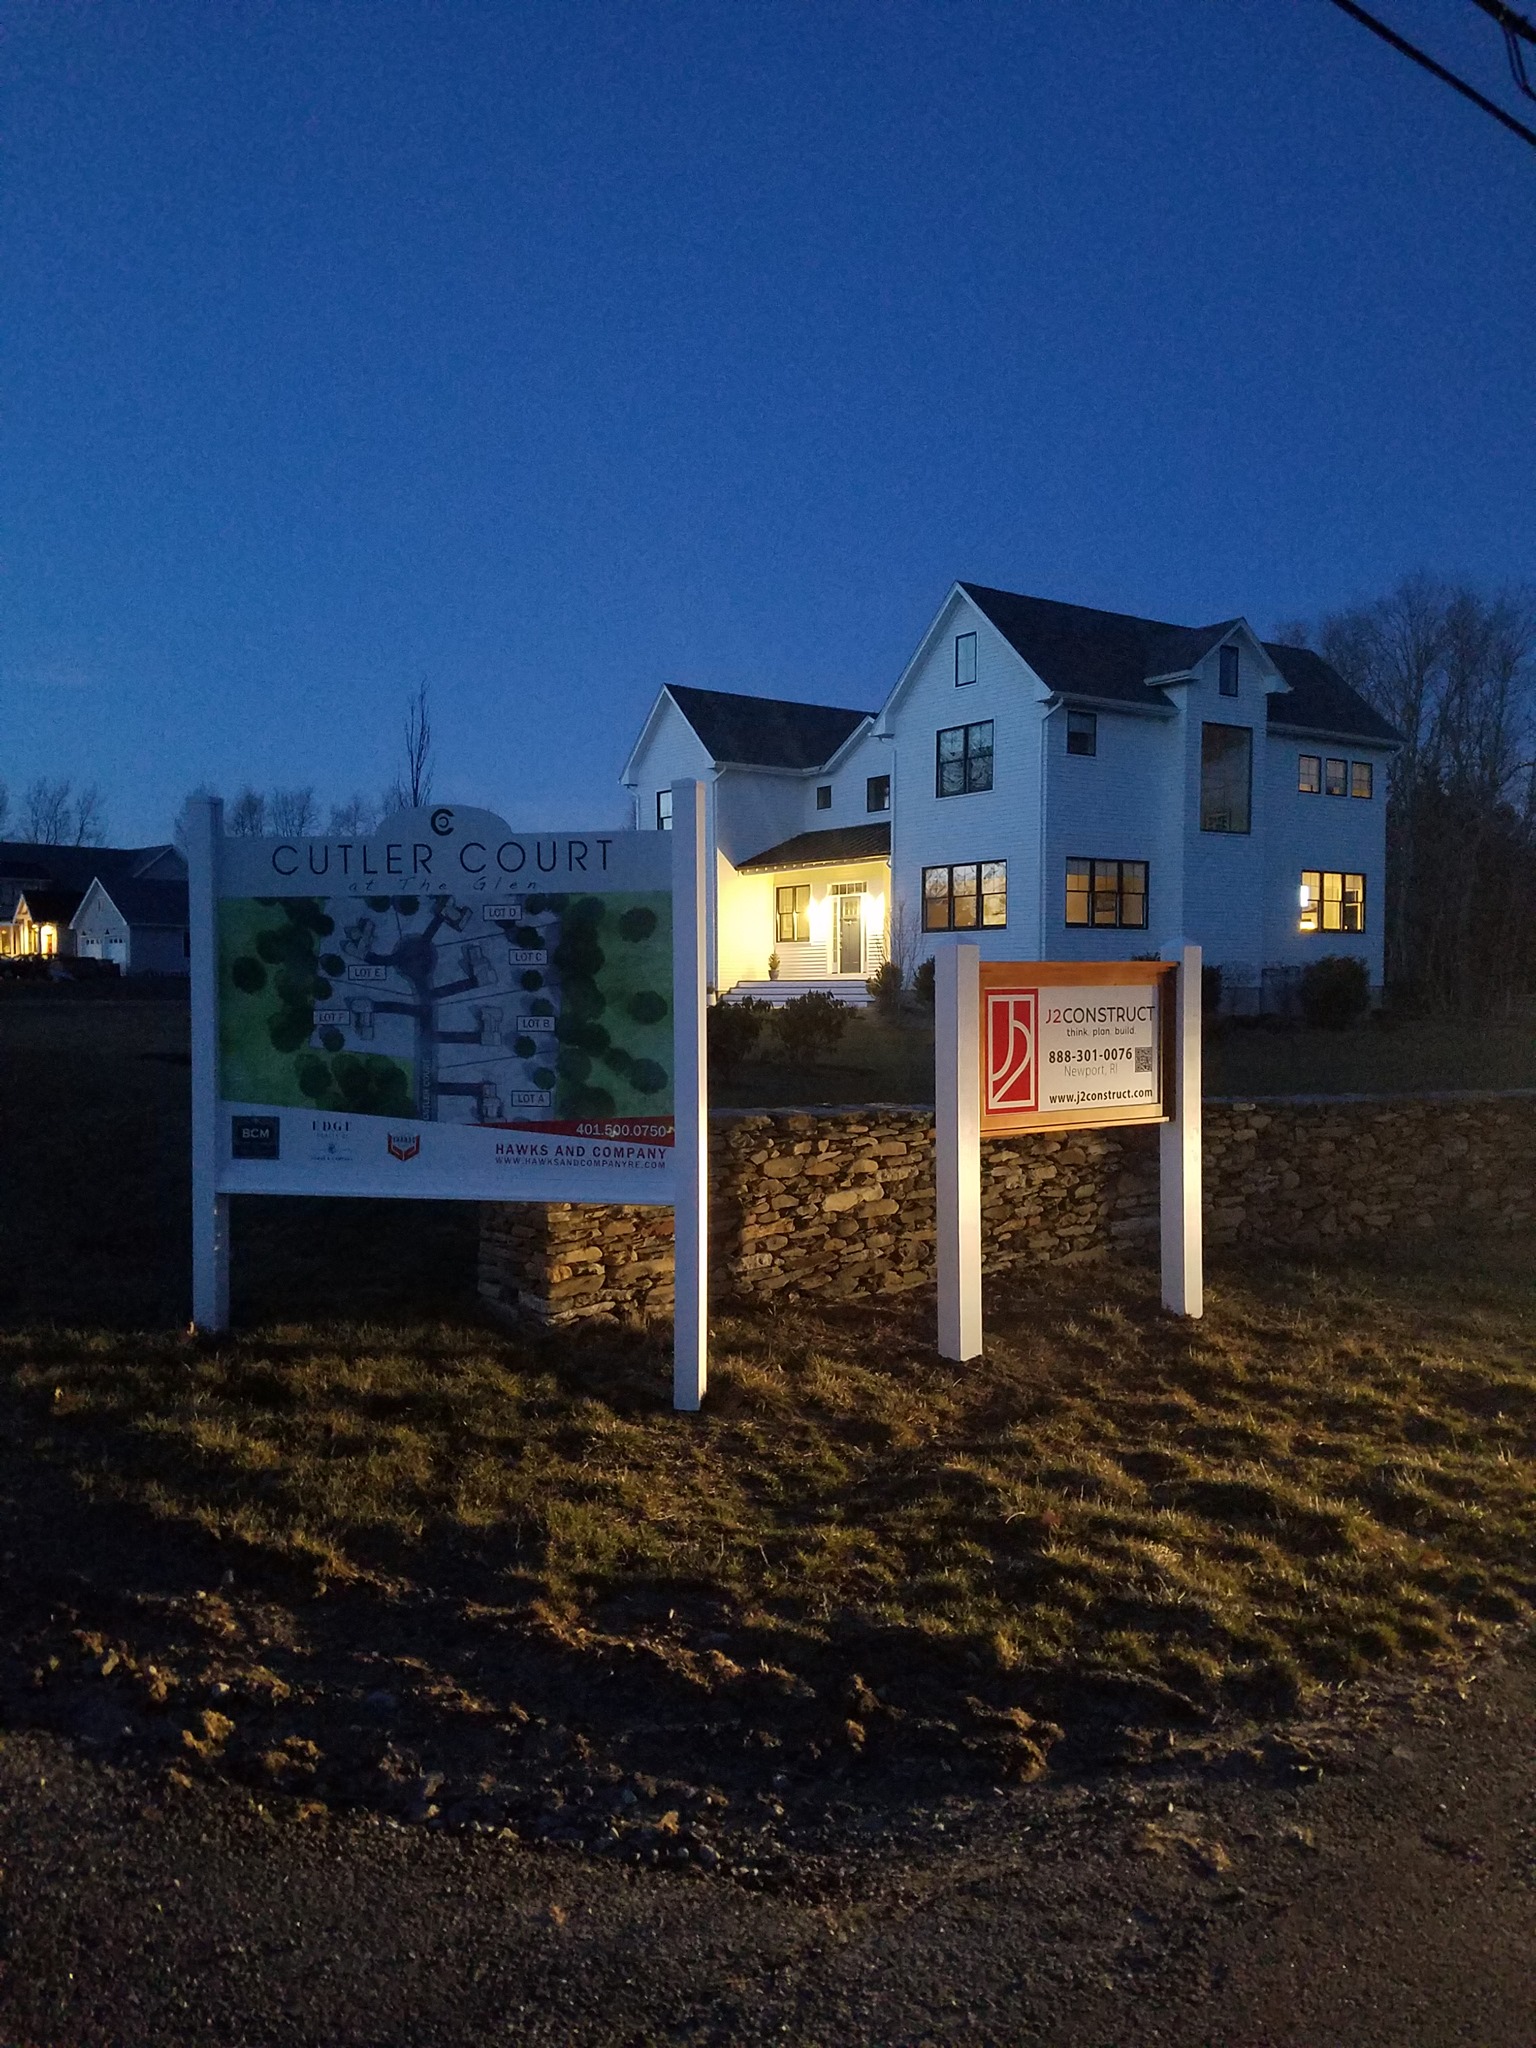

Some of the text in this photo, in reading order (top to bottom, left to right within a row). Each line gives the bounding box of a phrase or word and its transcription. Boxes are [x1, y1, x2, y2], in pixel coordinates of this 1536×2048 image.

[271, 840, 612, 876] CUTLER COURT
[348, 876, 538, 891] at The Glen
[489, 908, 516, 918] LOT D
[515, 952, 543, 962] LOT C
[354, 969, 381, 978] LOT E
[319, 1013, 336, 1022] LOT
[1045, 1006, 1155, 1024] J2CONSTRUCT
[522, 1019, 550, 1028] LOT B
[1049, 1047, 1133, 1064] 888-301-0076
[1064, 1063, 1118, 1079] Newport, RI
[517, 1094, 545, 1104] LOT A
[1049, 1089, 1153, 1105] www.j2construct.com
[242, 1128, 270, 1139] BCM
[576, 1123, 667, 1137] 401.500.0750
[495, 1144, 667, 1160] HAWKS AND COMPANY
[495, 1157, 666, 1169] WWW.HAWKSANDCOMPANYRE.COM
